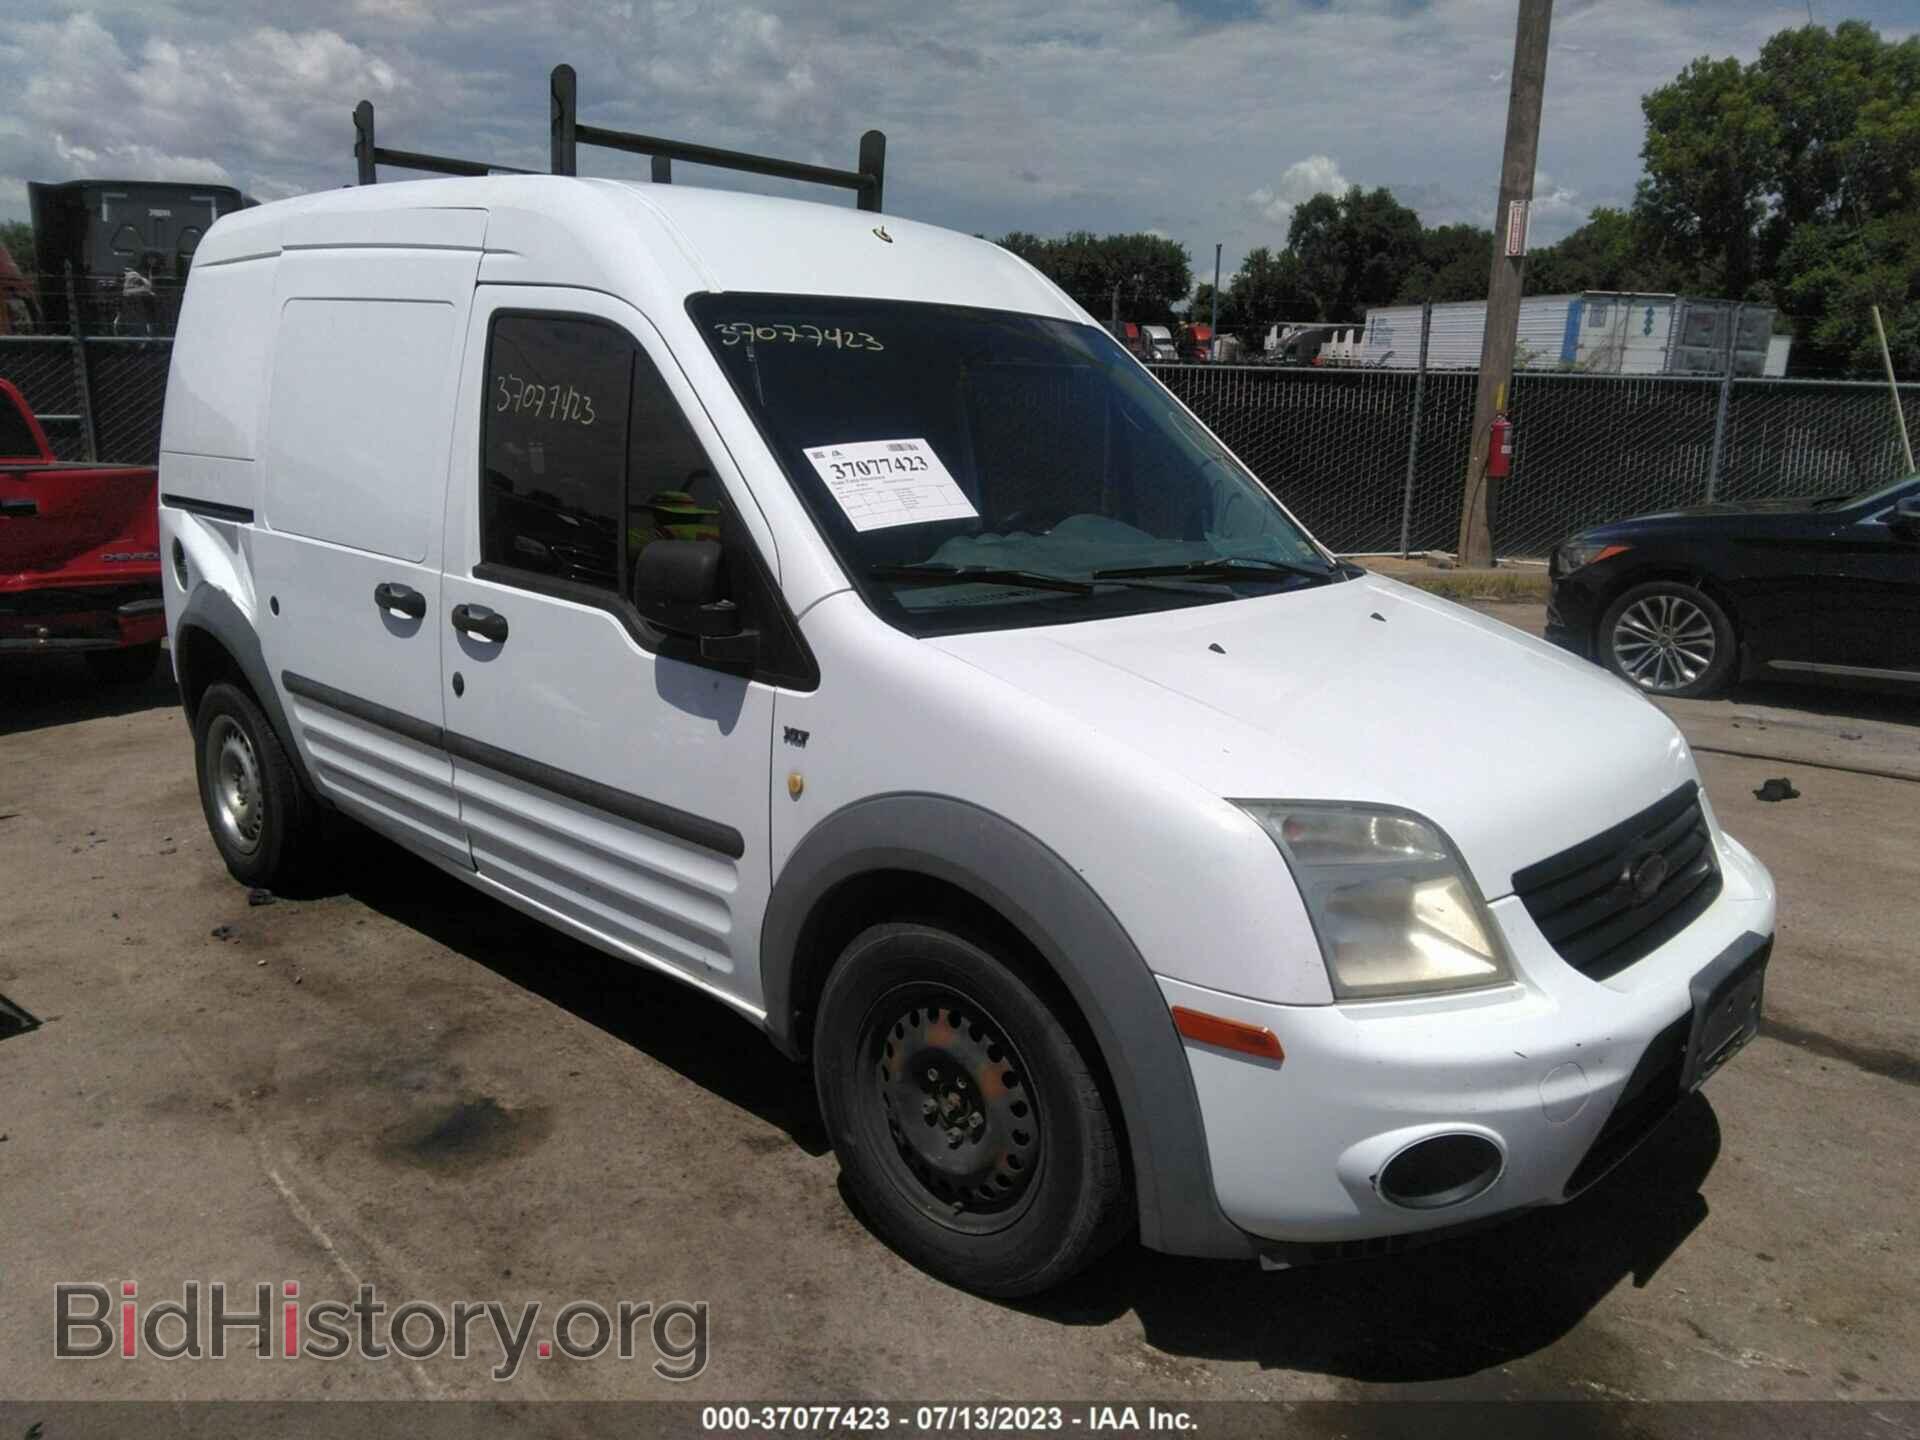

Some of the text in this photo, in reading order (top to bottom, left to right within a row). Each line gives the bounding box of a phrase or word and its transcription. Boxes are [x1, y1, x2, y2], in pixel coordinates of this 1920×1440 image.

[714, 323, 884, 351] 37077423
[496, 374, 596, 425] 37077423
[830, 455, 929, 480] 37077423
